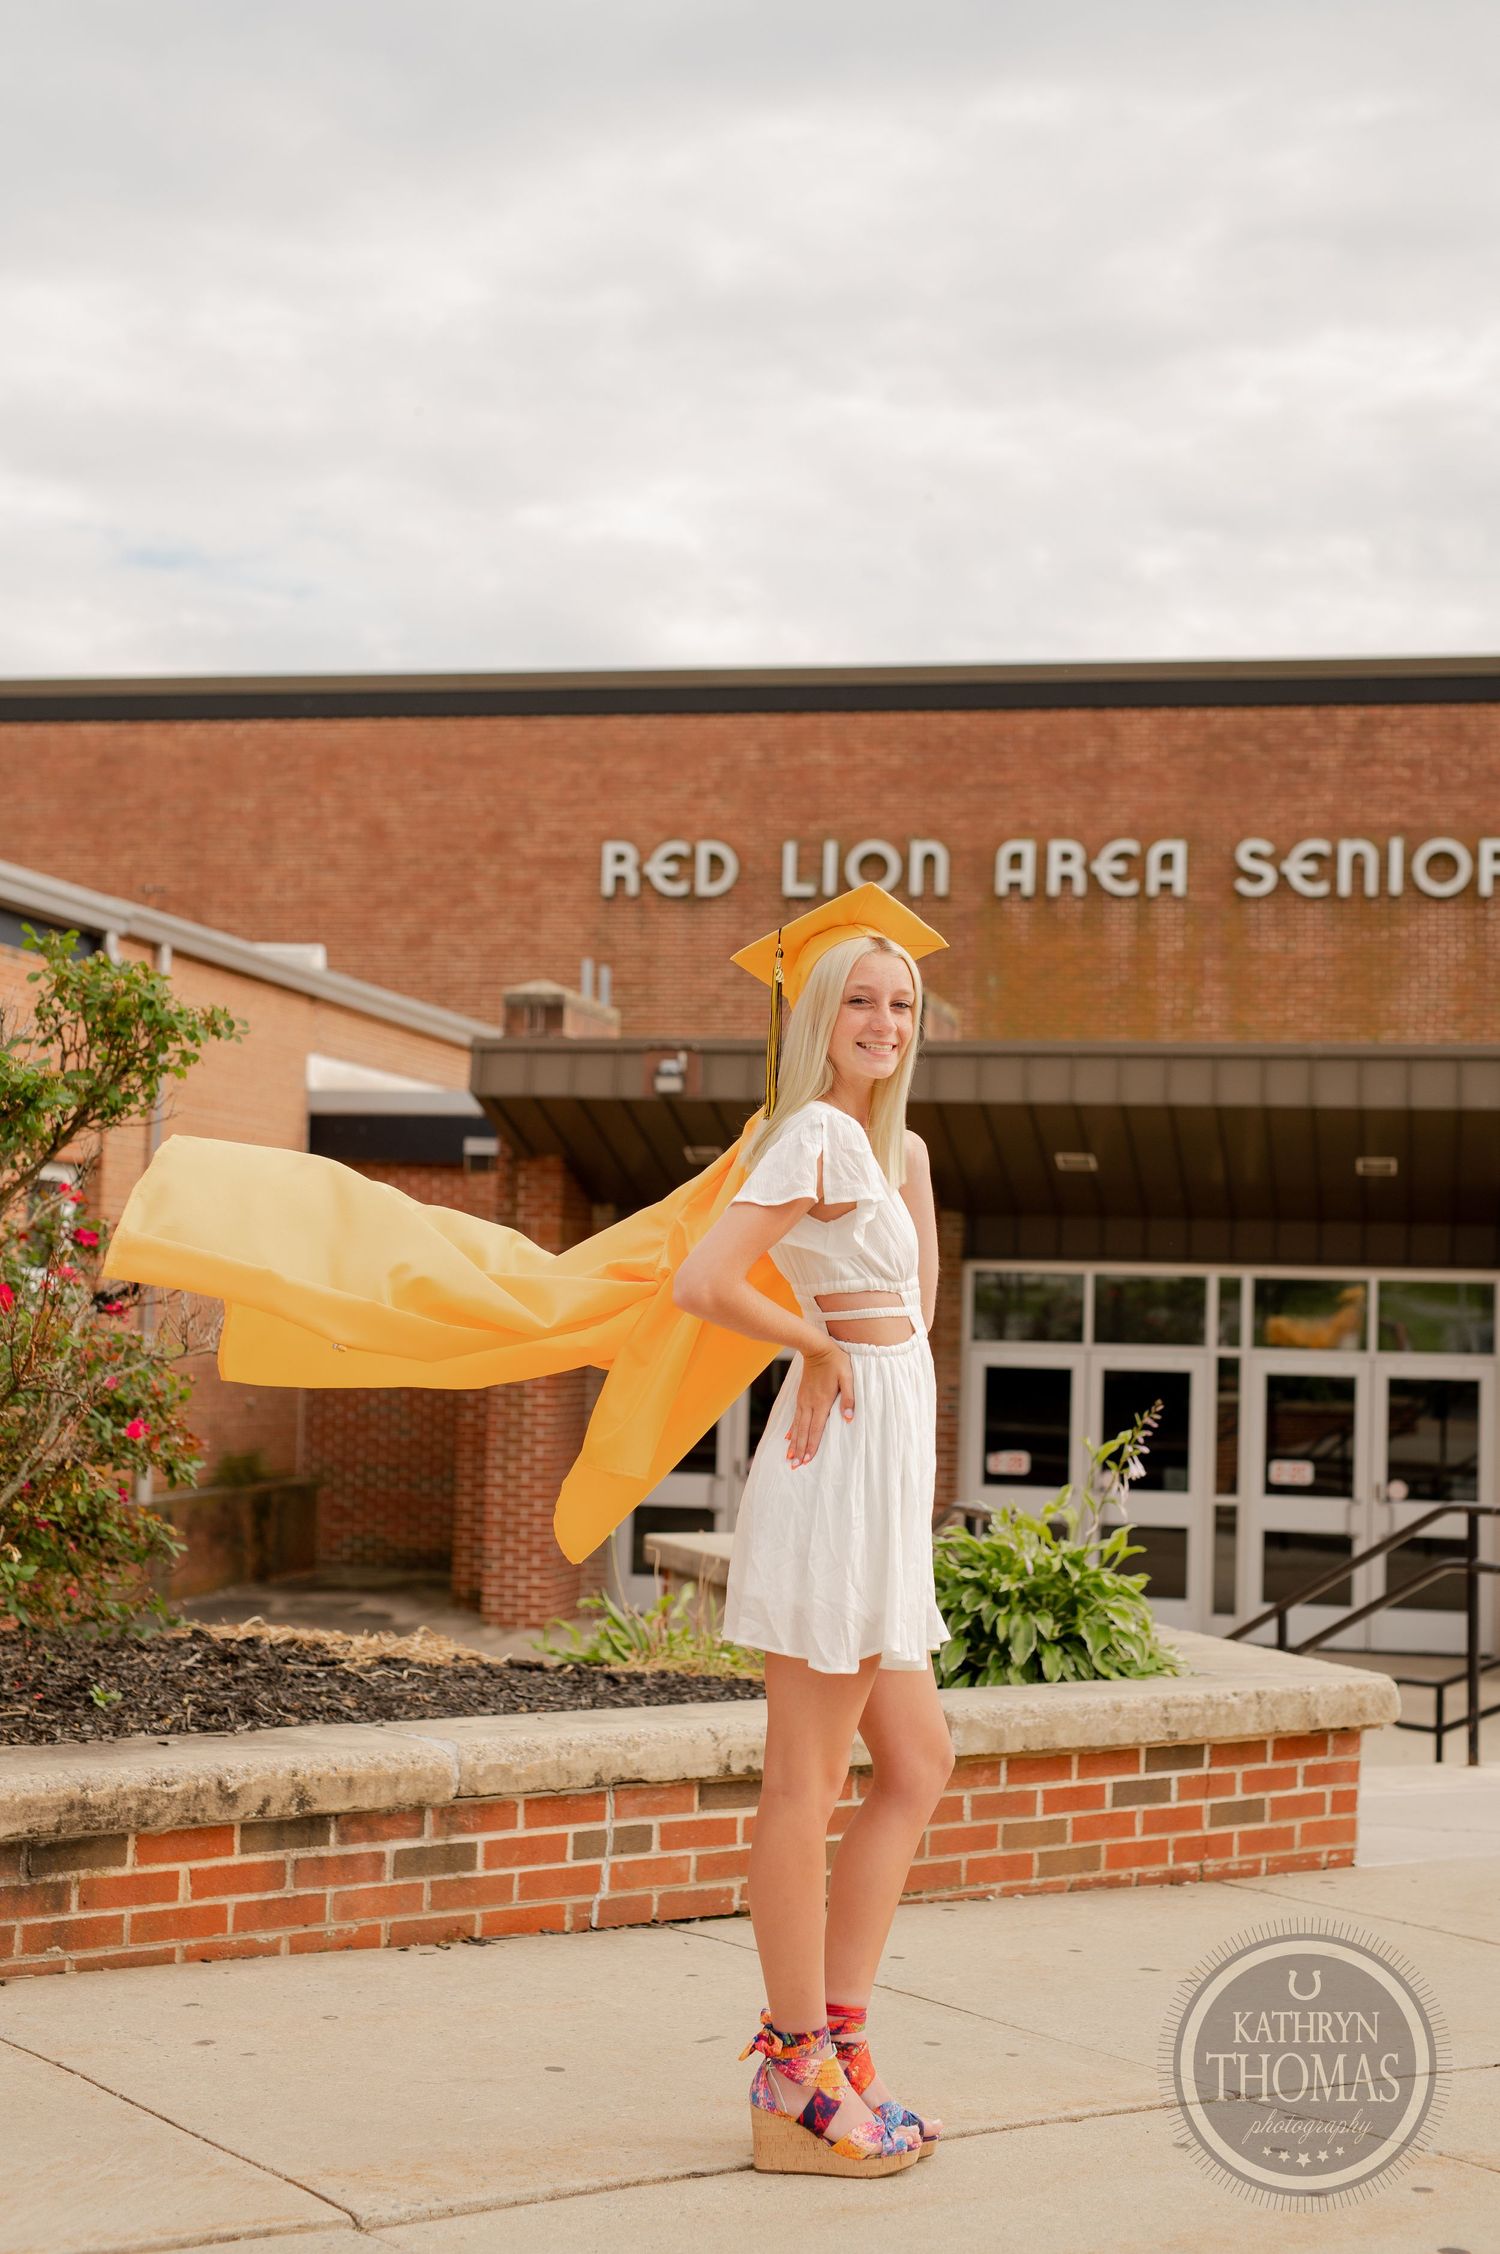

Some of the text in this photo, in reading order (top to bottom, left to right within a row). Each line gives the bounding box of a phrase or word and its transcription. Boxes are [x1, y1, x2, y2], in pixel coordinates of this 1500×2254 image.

[601, 839, 739, 897] RED
[781, 838, 950, 897] LION
[994, 838, 1188, 897] AREA
